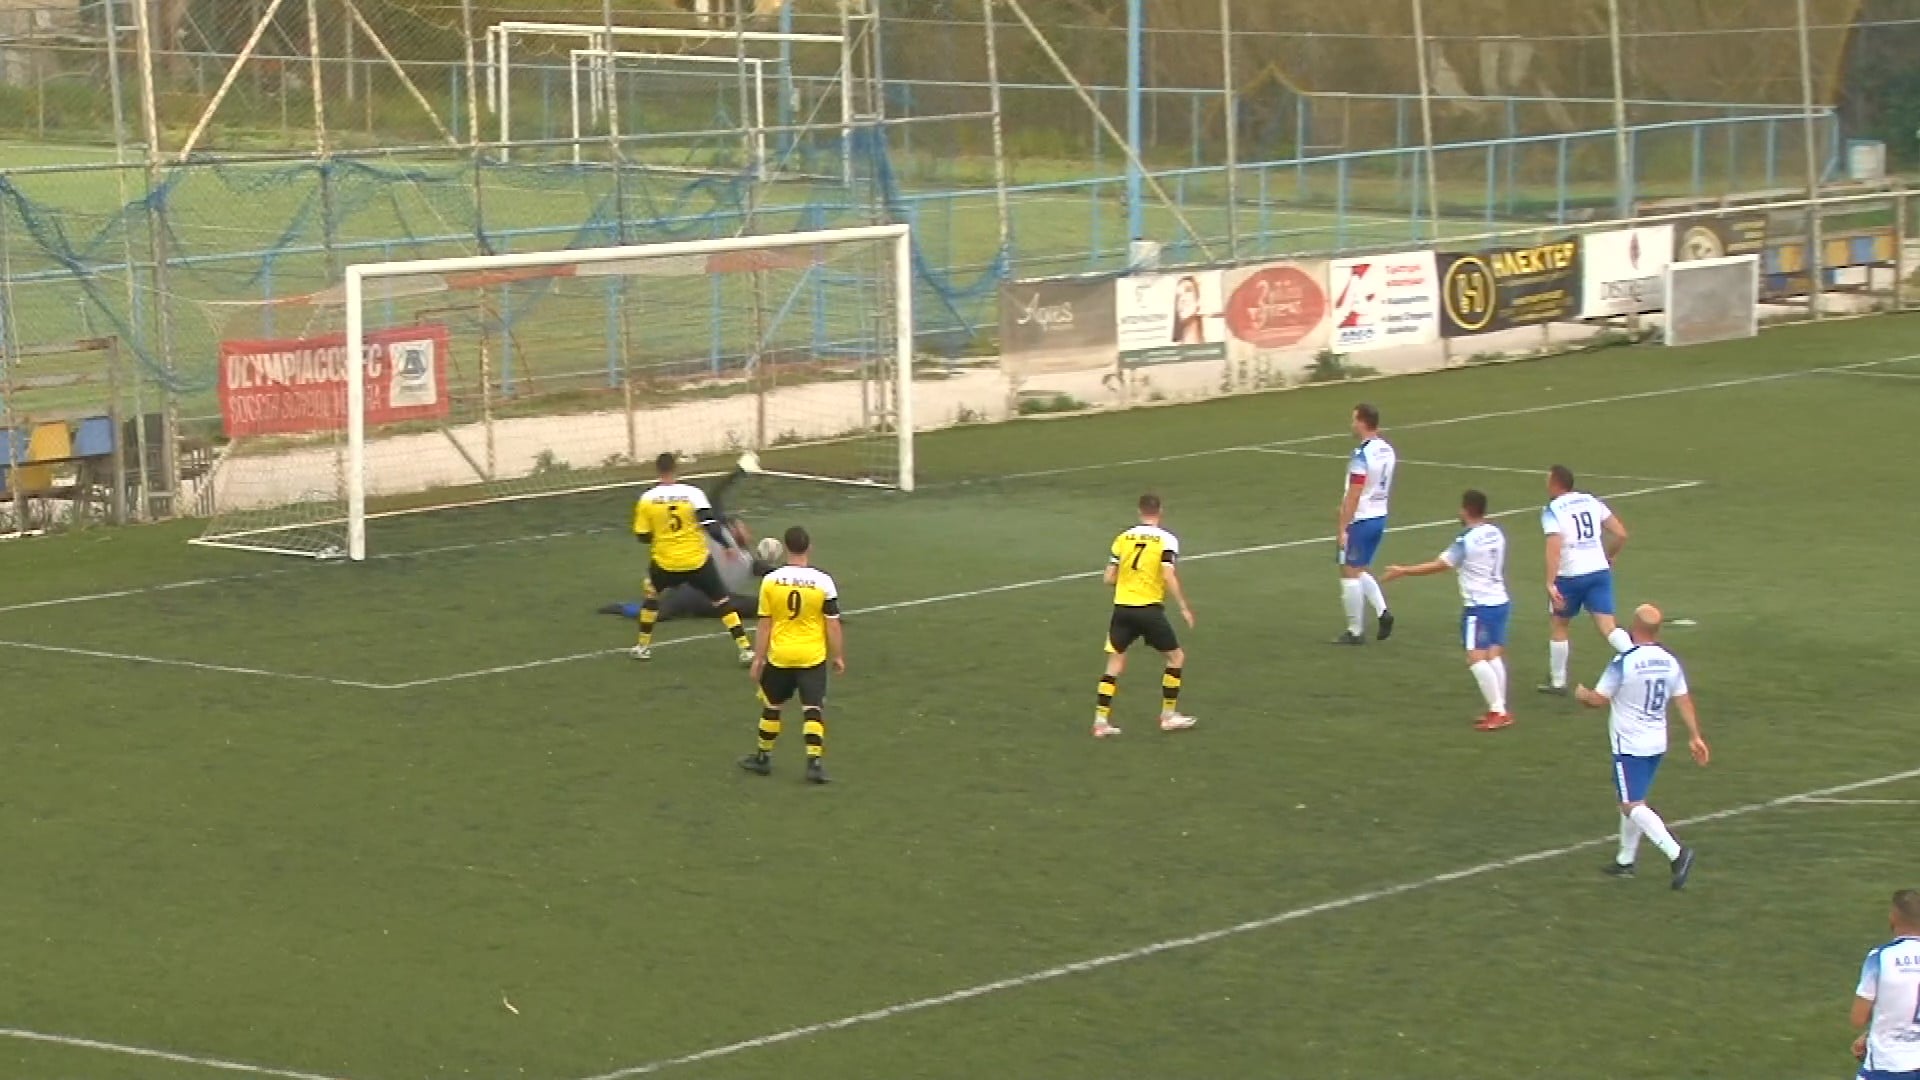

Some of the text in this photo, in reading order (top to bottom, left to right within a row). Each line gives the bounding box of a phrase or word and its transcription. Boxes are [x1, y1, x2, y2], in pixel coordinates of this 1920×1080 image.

[668, 505, 683, 533] 5
[1571, 511, 1595, 541] 19
[1131, 543, 1147, 571] 7
[787, 589, 802, 621] 9
[1643, 677, 1666, 716] 18
